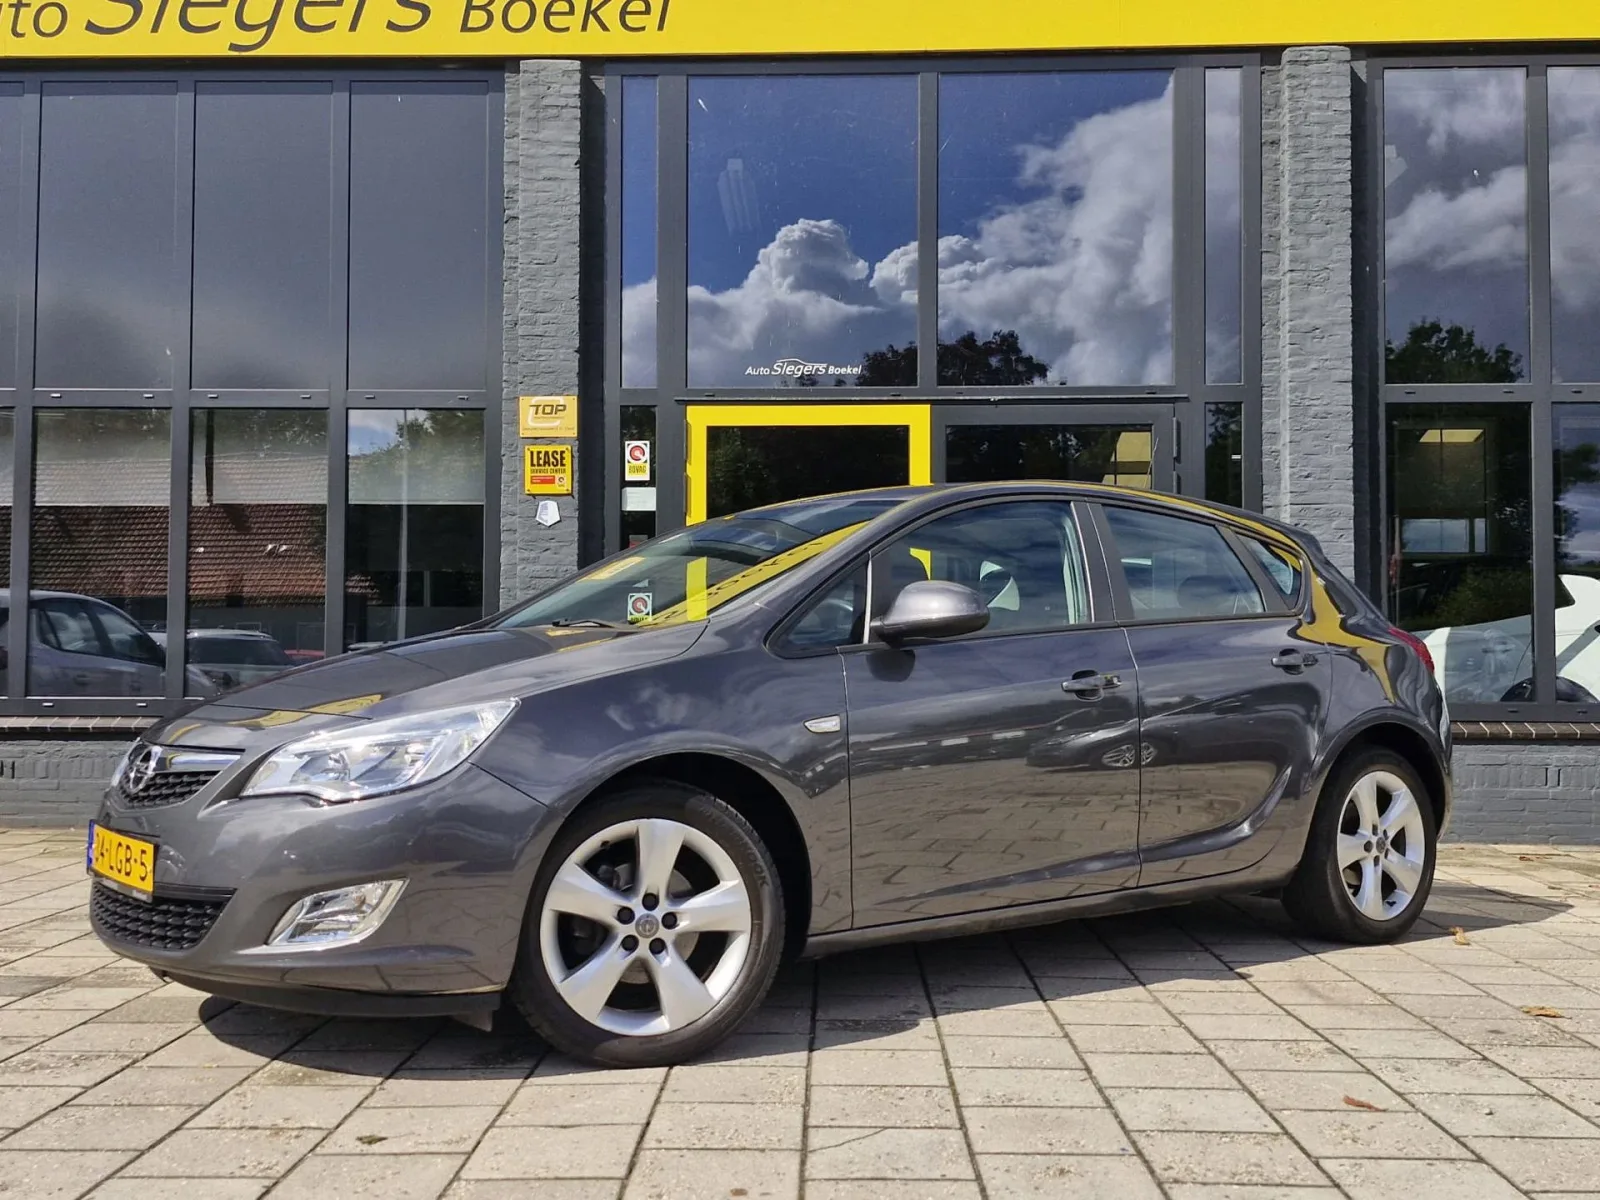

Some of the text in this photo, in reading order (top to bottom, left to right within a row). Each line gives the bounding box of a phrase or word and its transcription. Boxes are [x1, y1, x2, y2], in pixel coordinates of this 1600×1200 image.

[0, 0, 67, 38] to
[460, 0, 669, 33] Boekel
[745, 362, 862, 377] Auto Slegers Boekel
[529, 404, 567, 415] TOP
[530, 450, 566, 467] LEASE
